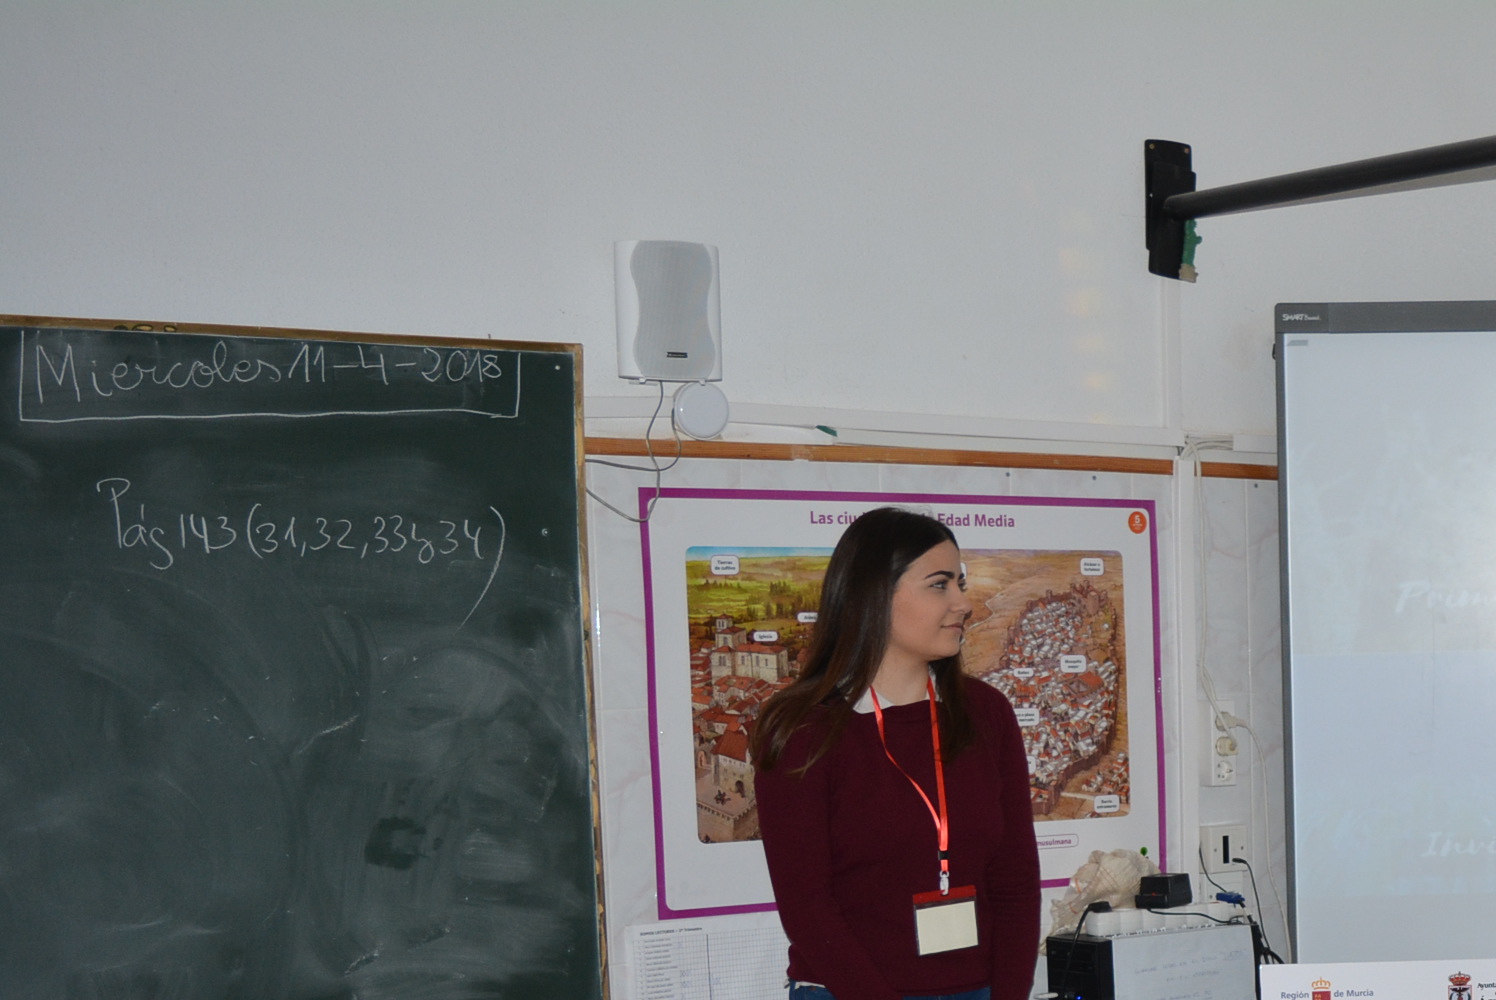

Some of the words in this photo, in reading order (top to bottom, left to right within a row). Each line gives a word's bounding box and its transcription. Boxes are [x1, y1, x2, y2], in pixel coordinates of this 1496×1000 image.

[1282, 313, 1304, 321] SMART
[97, 478, 174, 570] Pág
[810, 510, 834, 525] Las
[937, 513, 970, 527] Edad
[974, 513, 1015, 528] Media
[1134, 515, 1141, 524] 5
[1280, 990, 1310, 1000] Región
[1333, 990, 1344, 998] de
[1346, 988, 1374, 998] Murcia
